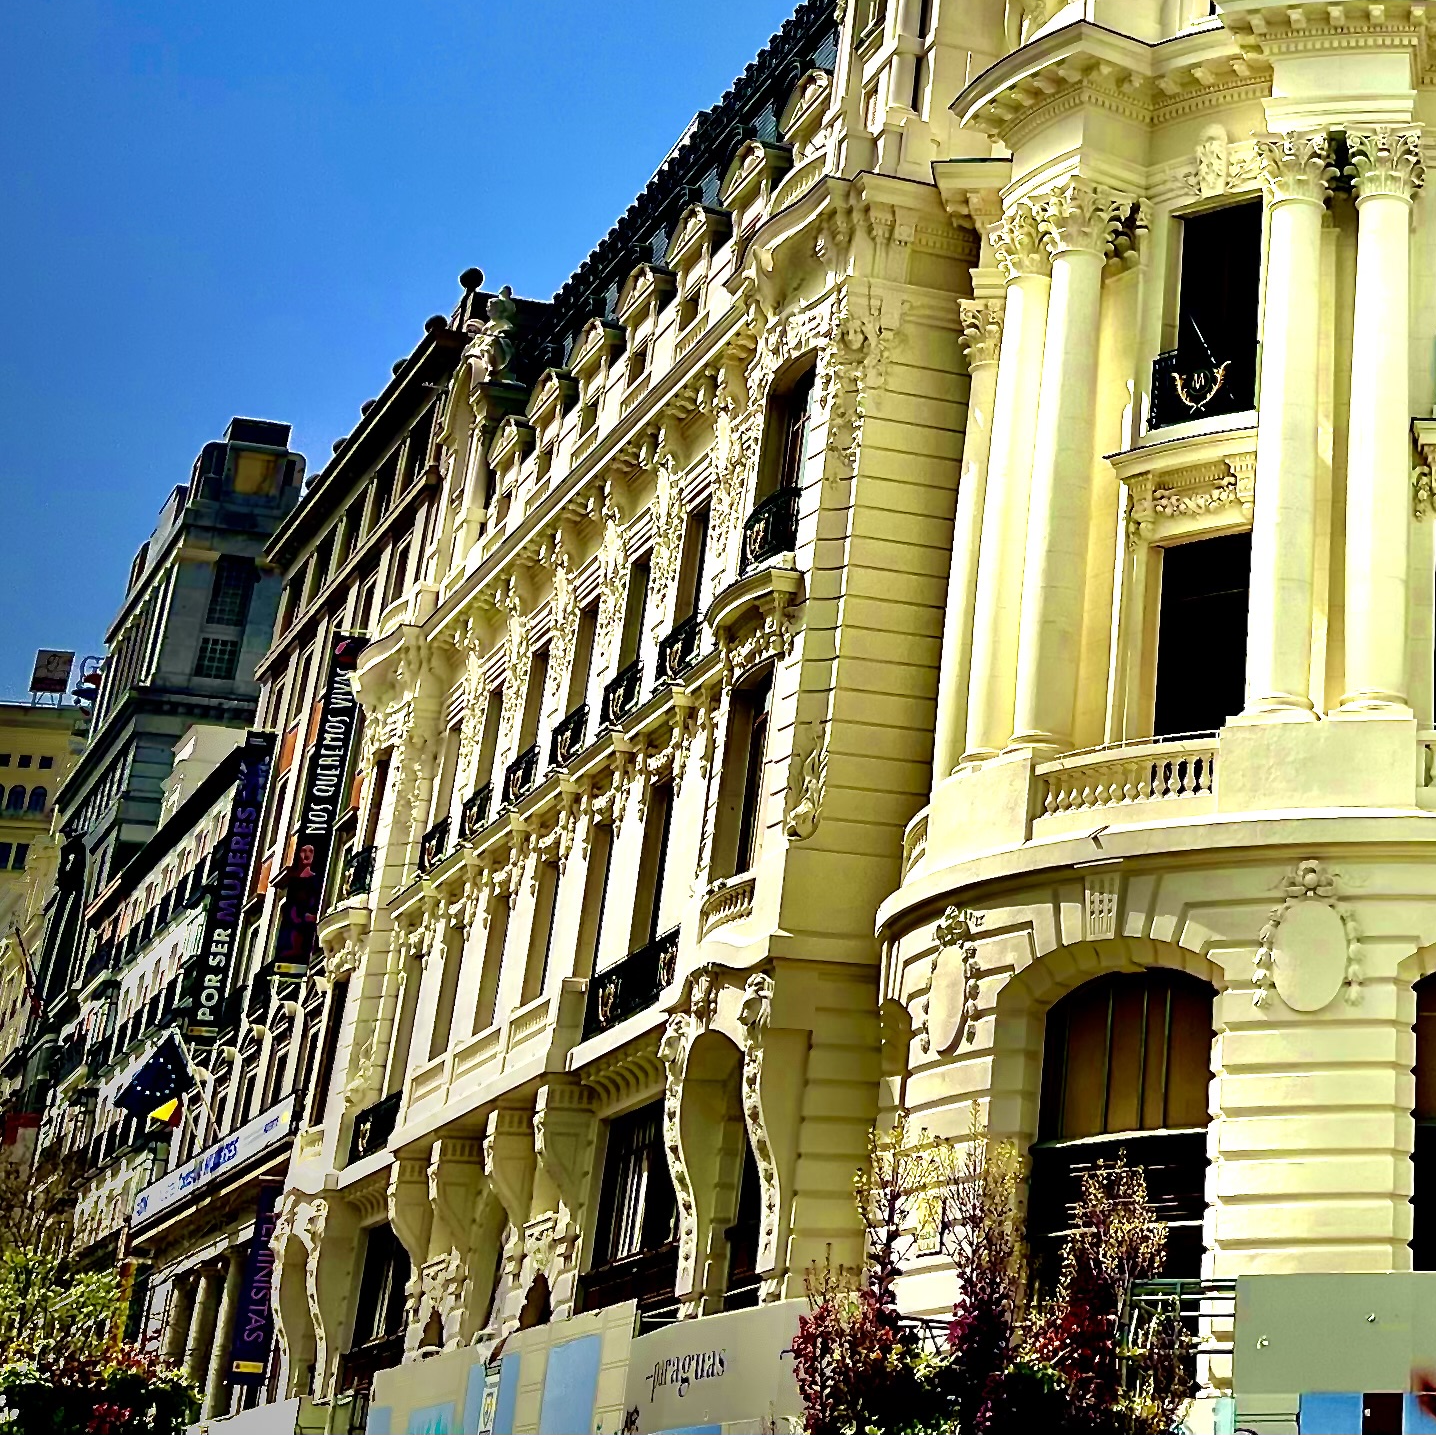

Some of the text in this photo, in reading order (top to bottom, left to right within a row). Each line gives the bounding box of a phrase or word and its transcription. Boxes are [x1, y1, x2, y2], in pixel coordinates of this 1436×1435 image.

[305, 802, 333, 835] NOS
[196, 806, 257, 1021] POR SER MUJERES
